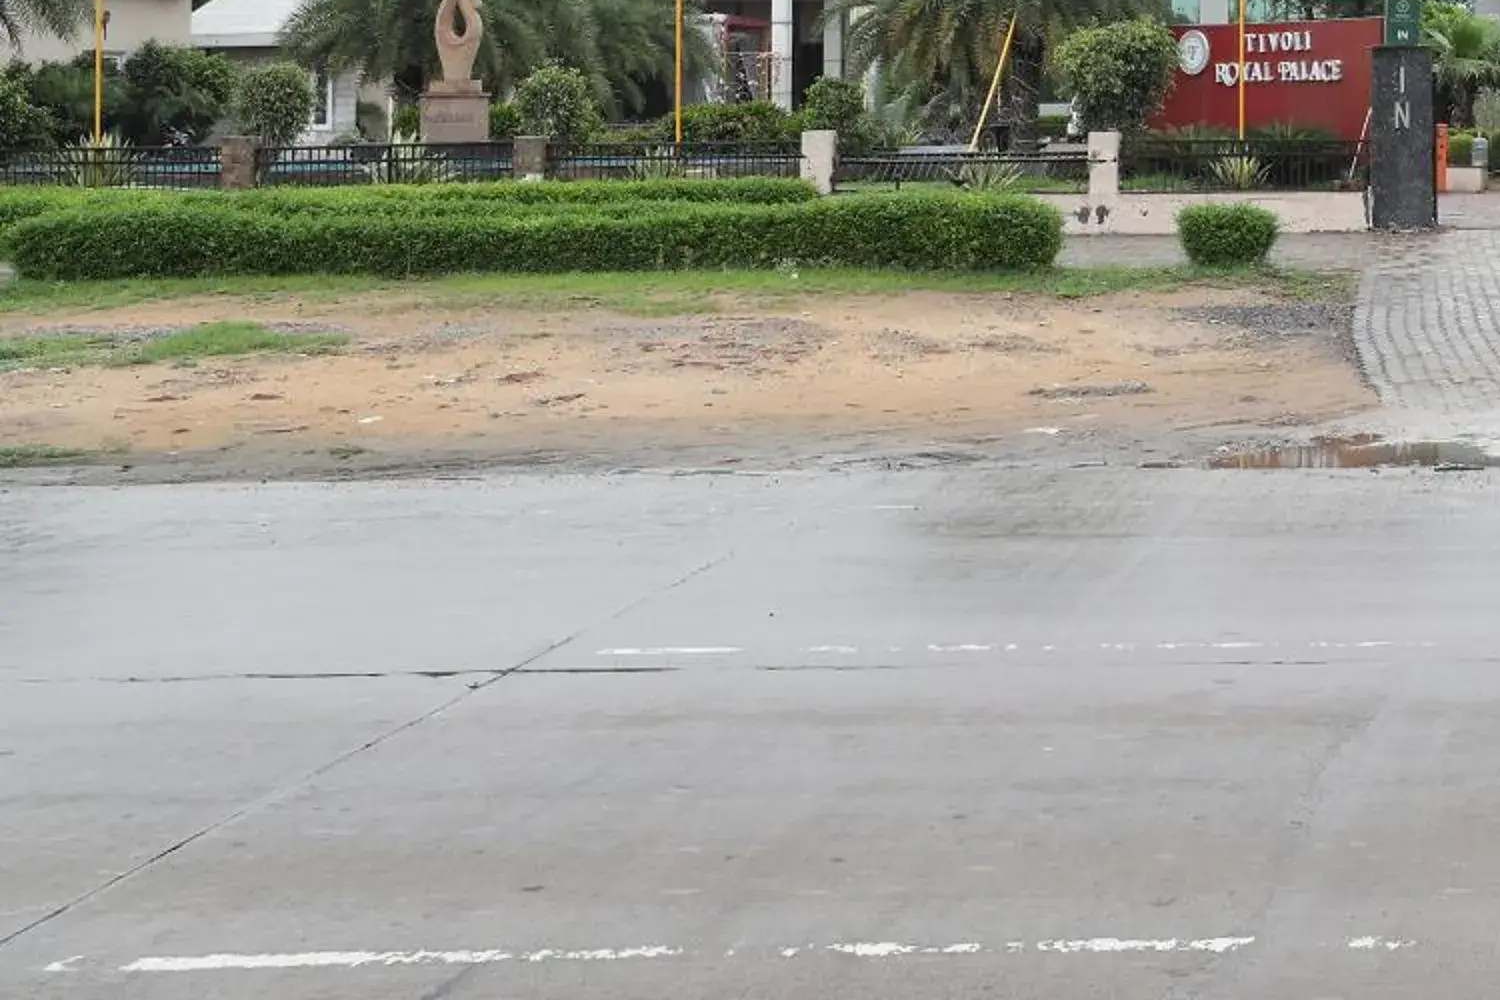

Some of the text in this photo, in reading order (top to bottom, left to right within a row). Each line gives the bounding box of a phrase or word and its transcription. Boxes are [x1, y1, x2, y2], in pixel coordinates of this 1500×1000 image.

[1244, 31, 1312, 53] TIVOLI
[1397, 29, 1409, 40] IN
[1215, 60, 1343, 86] ROYAL PALACE
